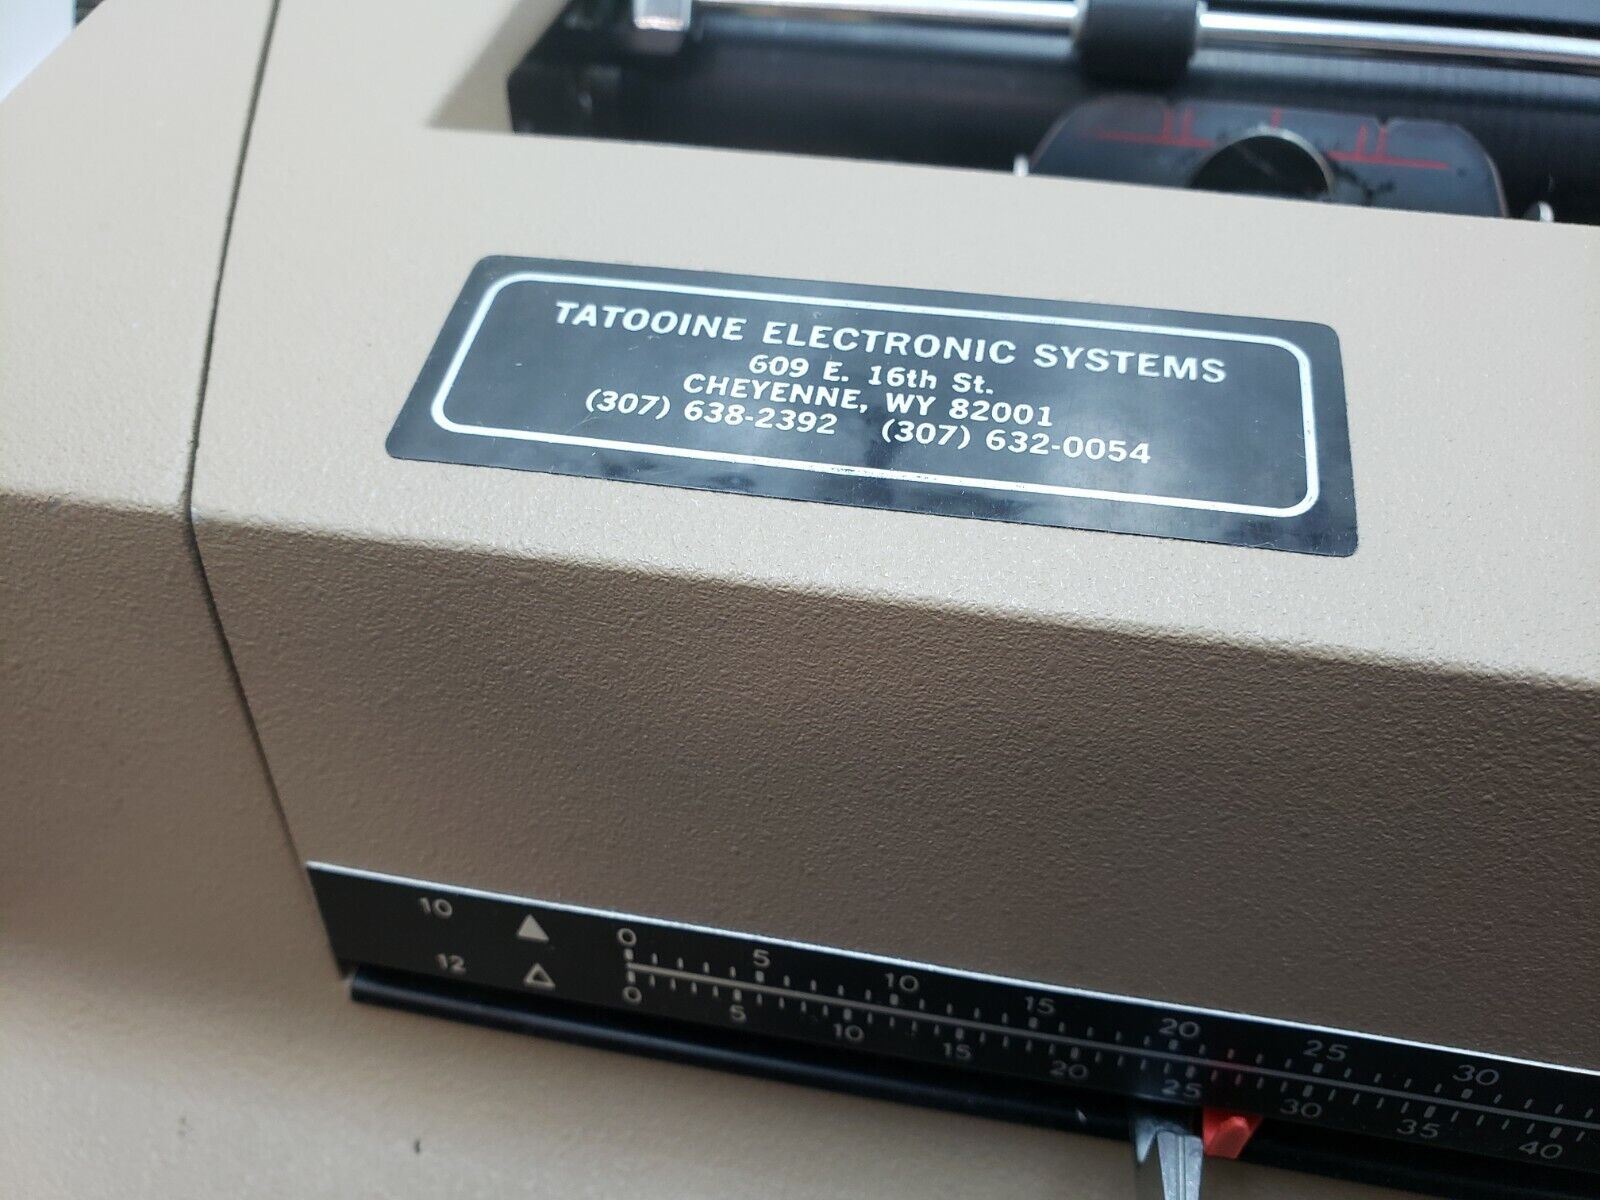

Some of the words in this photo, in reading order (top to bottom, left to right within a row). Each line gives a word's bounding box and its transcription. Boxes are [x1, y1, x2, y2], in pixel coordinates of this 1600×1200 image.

[555, 301, 747, 342] TATOOINE
[762, 321, 1017, 365] ELECTRONIC
[1034, 343, 1227, 384] SYSTEMS
[748, 354, 810, 378] 609
[823, 361, 849, 383] E.
[868, 365, 937, 390] 16th
[952, 372, 994, 396] St.
[585, 388, 671, 420] (307)
[684, 401, 838, 436] 638-2392
[881, 419, 971, 451] (307)
[985, 430, 1152, 464] 632-0054
[683, 373, 868, 414] CHEYENNE,
[885, 394, 936, 417] WY
[949, 400, 1053, 428] 82001
[419, 897, 453, 919] 10
[436, 954, 467, 973] 12
[885, 972, 921, 993] 10
[1026, 996, 1056, 1016] 15
[1158, 1018, 1201, 1039] 20
[1303, 1039, 1349, 1062] 25
[1452, 1063, 1500, 1087] 30
[833, 1023, 866, 1043] 10
[943, 1042, 972, 1061] 15
[1049, 1060, 1089, 1080] 20
[1161, 1079, 1202, 1099] 25
[1279, 1099, 1323, 1120] 30
[1396, 1118, 1441, 1140] 35
[1518, 1140, 1563, 1161] 40
